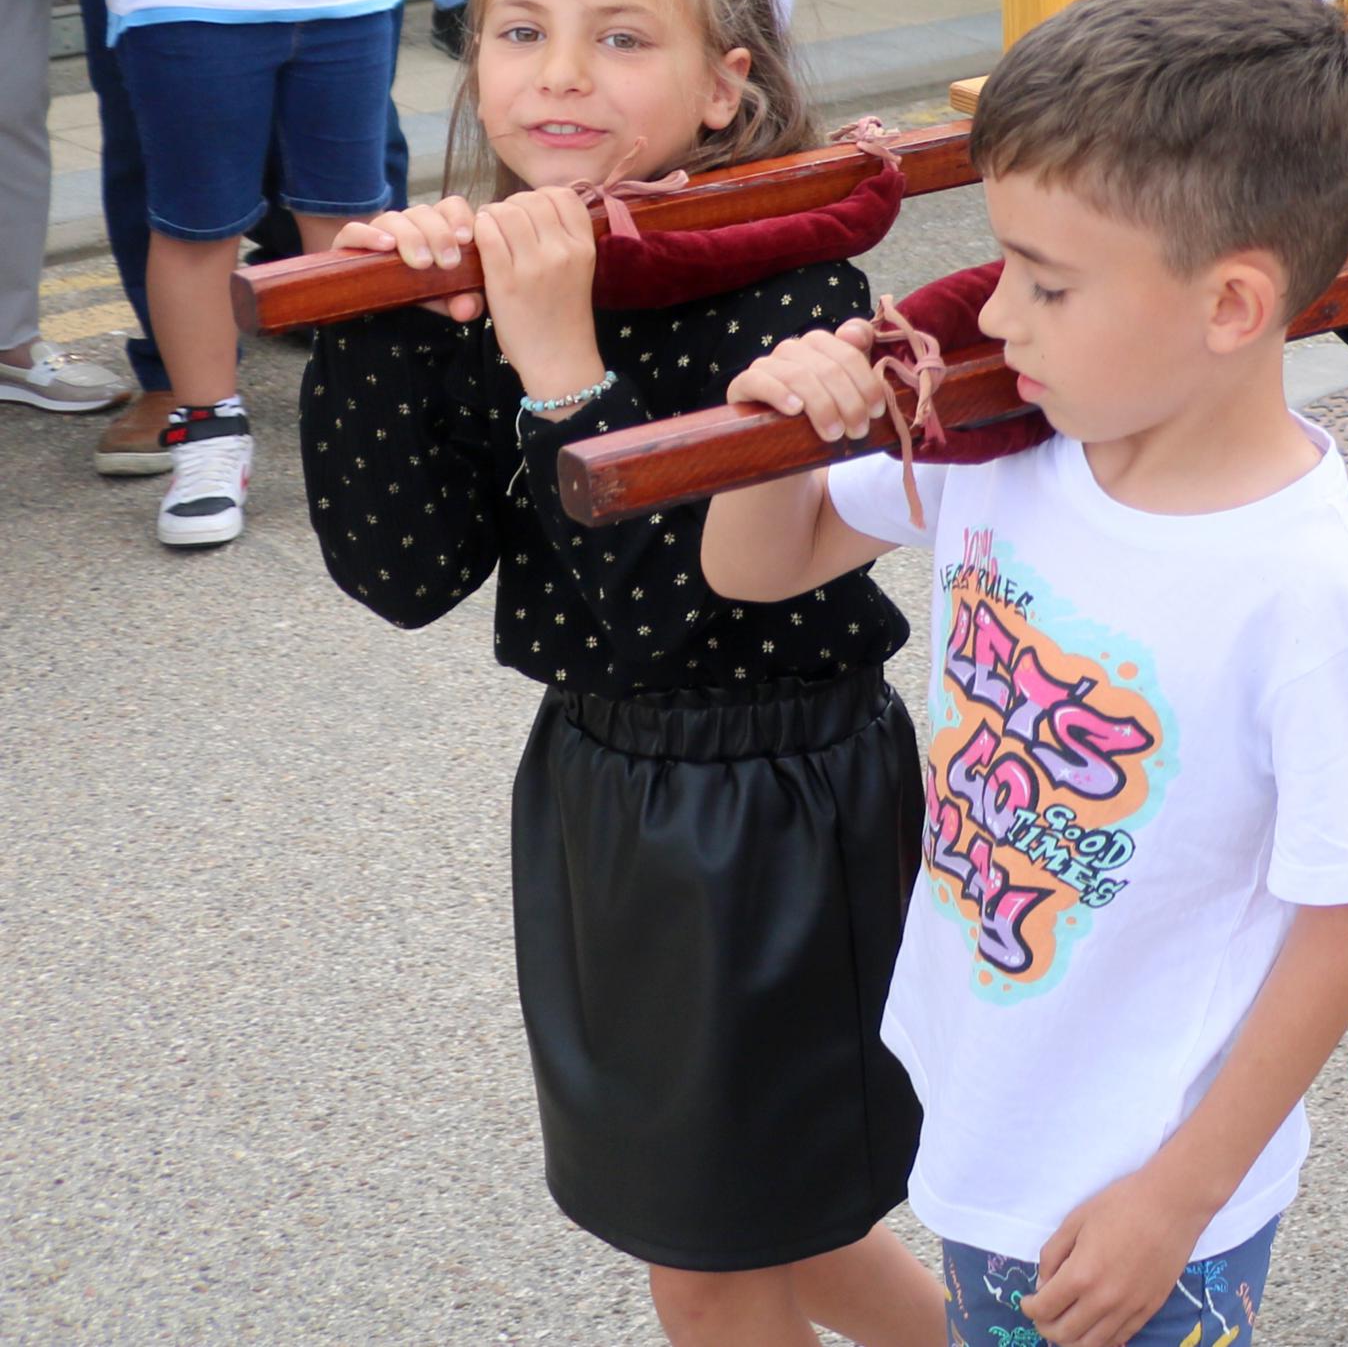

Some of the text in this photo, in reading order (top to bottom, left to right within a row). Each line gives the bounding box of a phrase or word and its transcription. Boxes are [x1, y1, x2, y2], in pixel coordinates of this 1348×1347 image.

[976, 568, 1034, 621] RULES
[945, 597, 1154, 800] LET'S
[947, 718, 1040, 846] GO
[1042, 804, 1136, 870] GOOD
